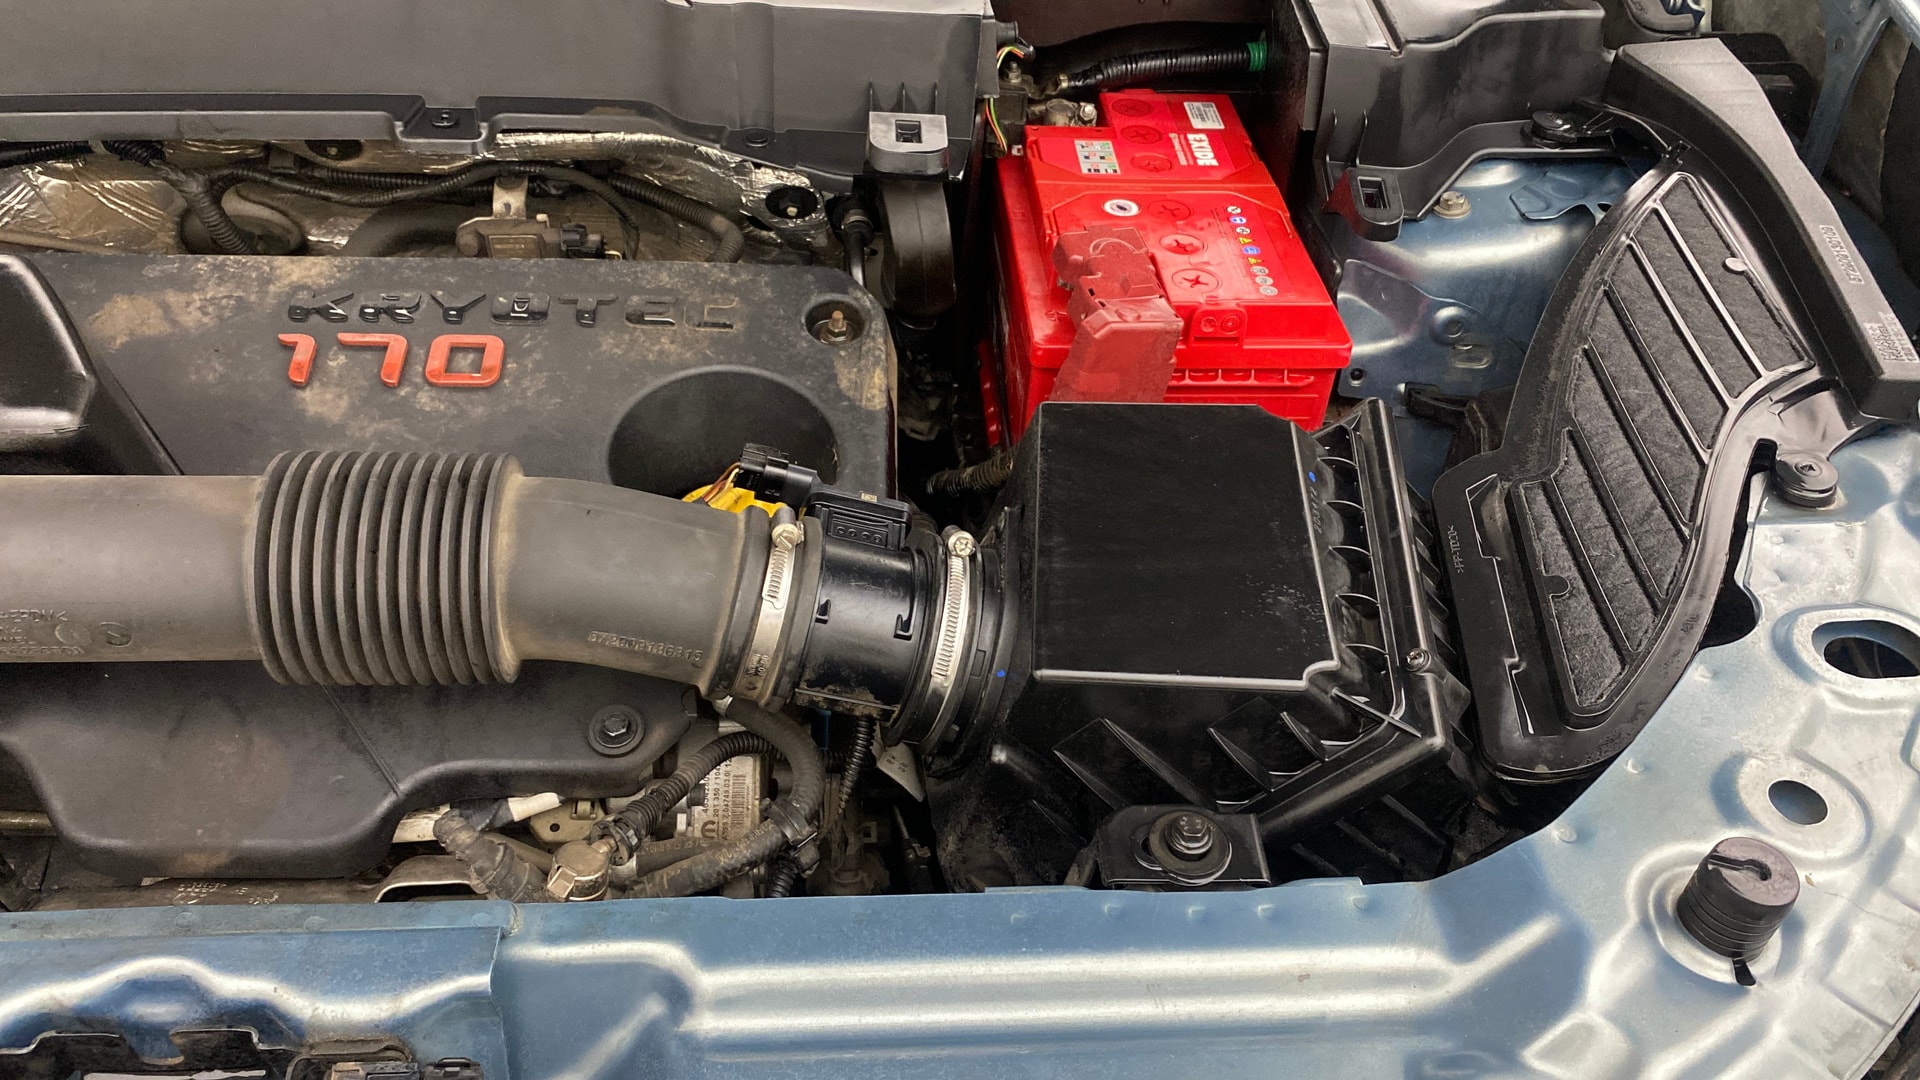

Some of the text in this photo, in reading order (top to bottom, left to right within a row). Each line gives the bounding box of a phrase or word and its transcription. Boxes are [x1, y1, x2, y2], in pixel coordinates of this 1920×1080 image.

[1187, 133, 1219, 166] EXIDE
[287, 291, 738, 332] KRYOTEC
[278, 332, 505, 388] 170
